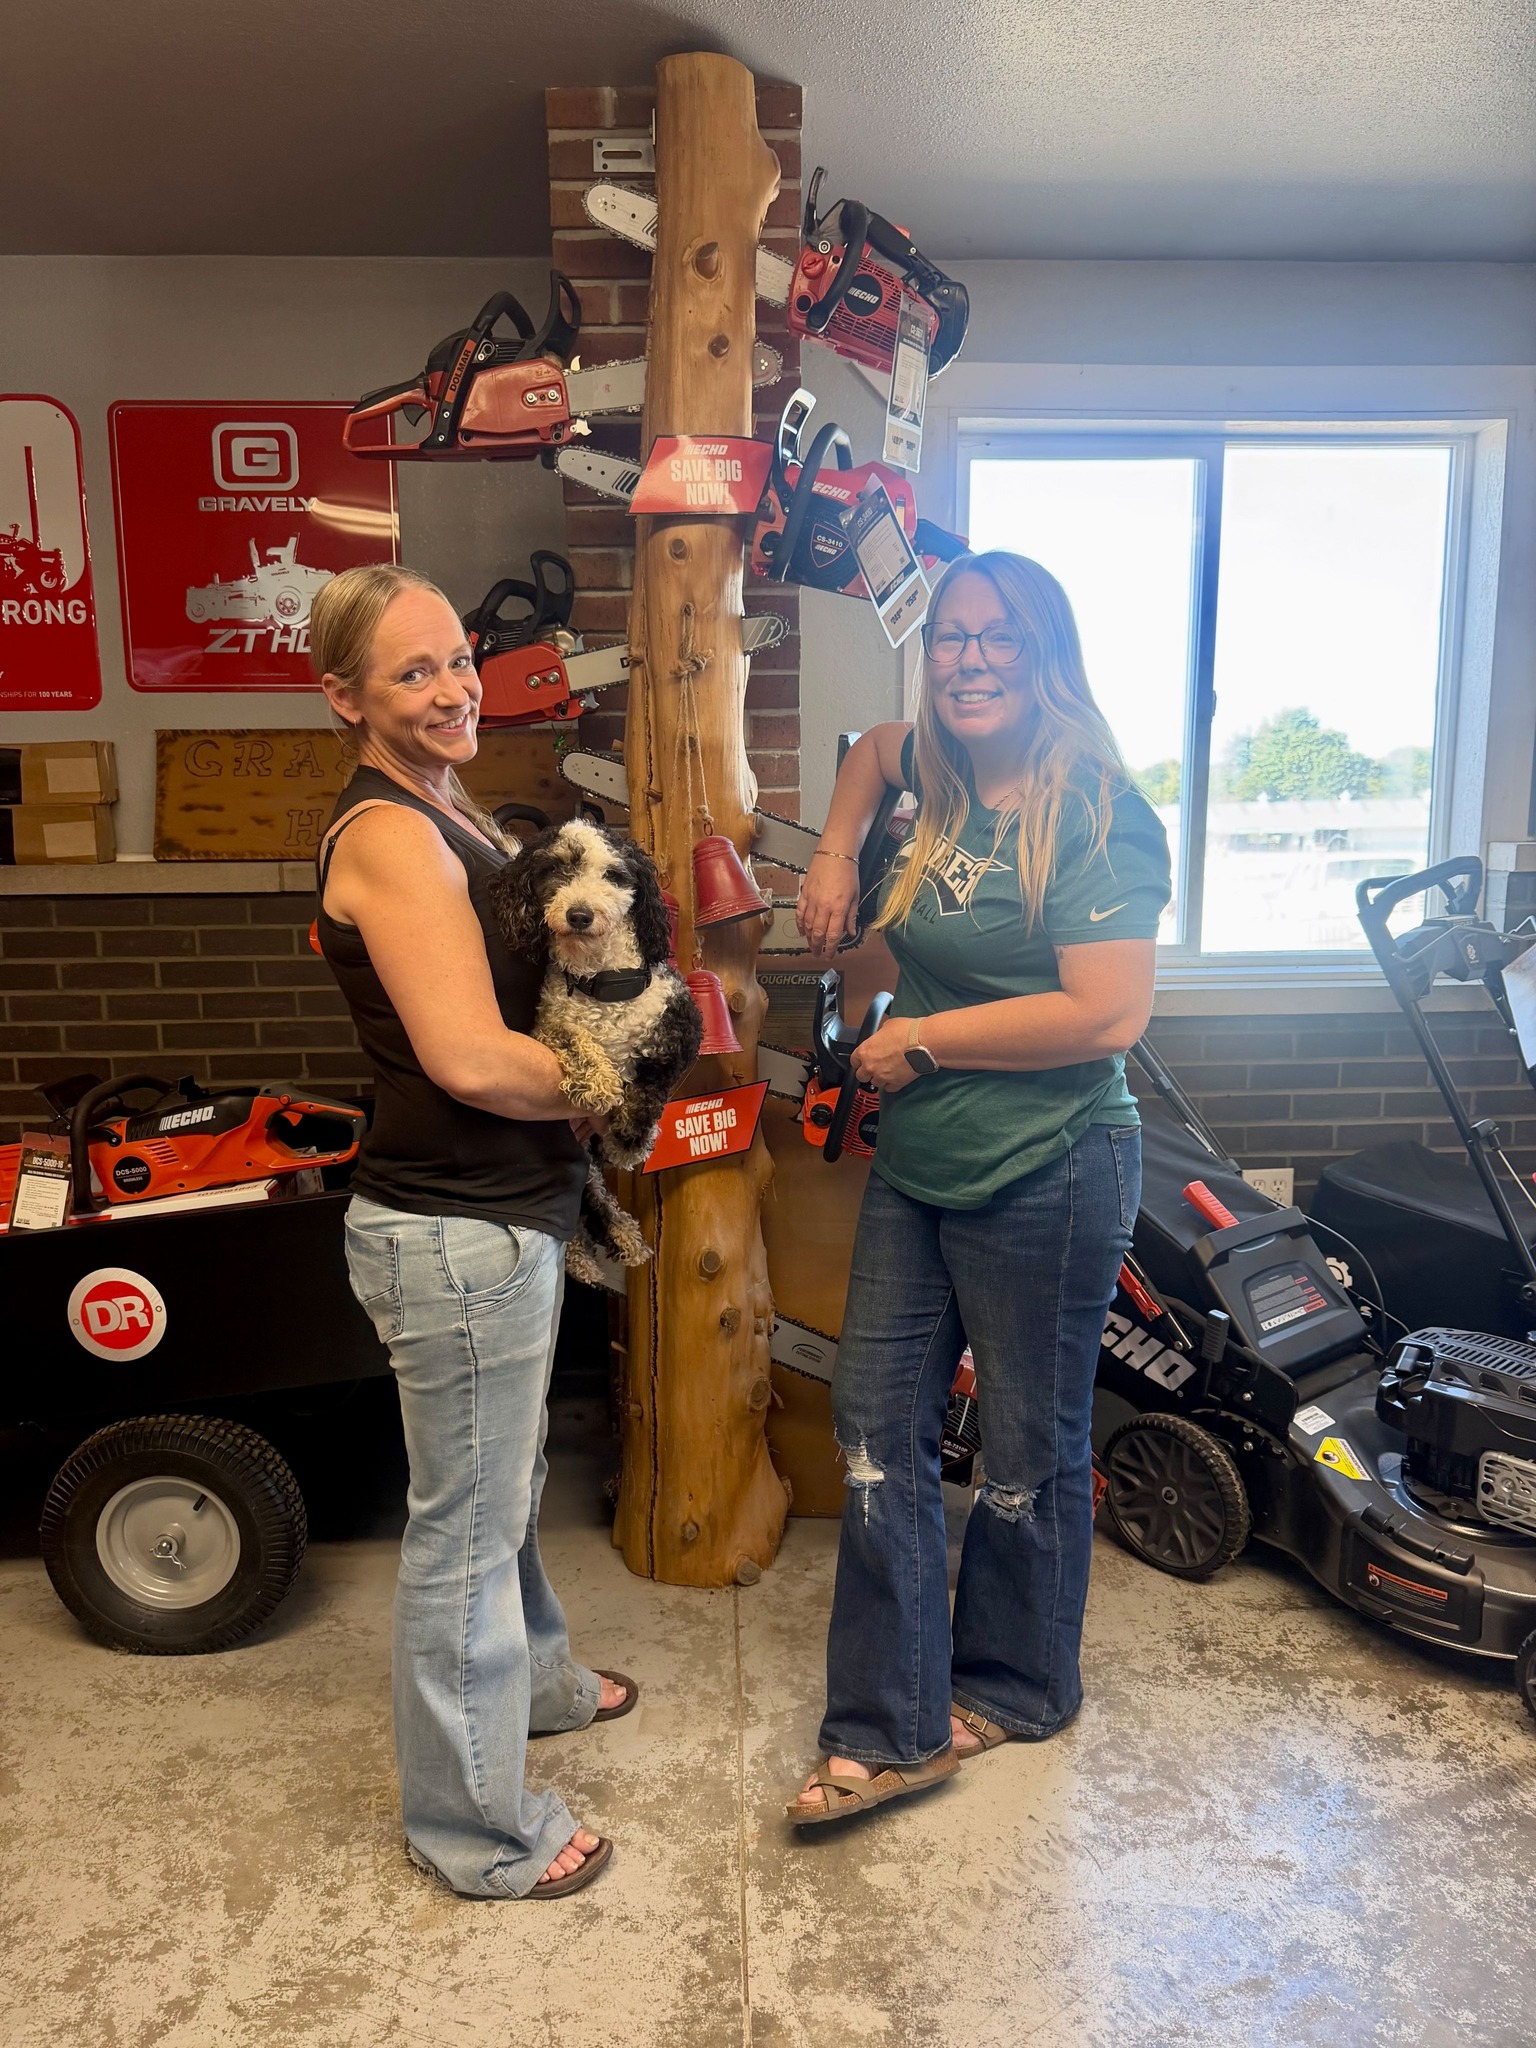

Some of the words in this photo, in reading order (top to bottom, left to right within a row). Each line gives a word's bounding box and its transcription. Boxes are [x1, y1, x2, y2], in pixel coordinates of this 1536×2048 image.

[852, 287, 880, 304] ECHO
[449, 349, 472, 393] DOLMAR
[692, 444, 729, 456] ECHO
[670, 459, 711, 482] SAVE
[714, 459, 743, 482] BIG
[686, 482, 730, 506] NOW!
[812, 481, 851, 500] ECHO
[198, 496, 317, 512] GRAVELY
[816, 534, 844, 548] CS-3410
[819, 544, 838, 556] ECHO
[204, 628, 267, 653] ZT
[24, 690, 37, 698] FOR
[39, 690, 51, 698] 100
[51, 690, 73, 698] YEARS
[692, 1097, 725, 1113] ECHO
[171, 1105, 215, 1129] ECHO
[675, 1113, 713, 1139] SAVE
[713, 1107, 737, 1131] BIG
[689, 1132, 728, 1157] NOW!
[115, 1166, 148, 1177] DCS-5000
[85, 1294, 151, 1335] DR
[1100, 1311, 1198, 1392] CHO
